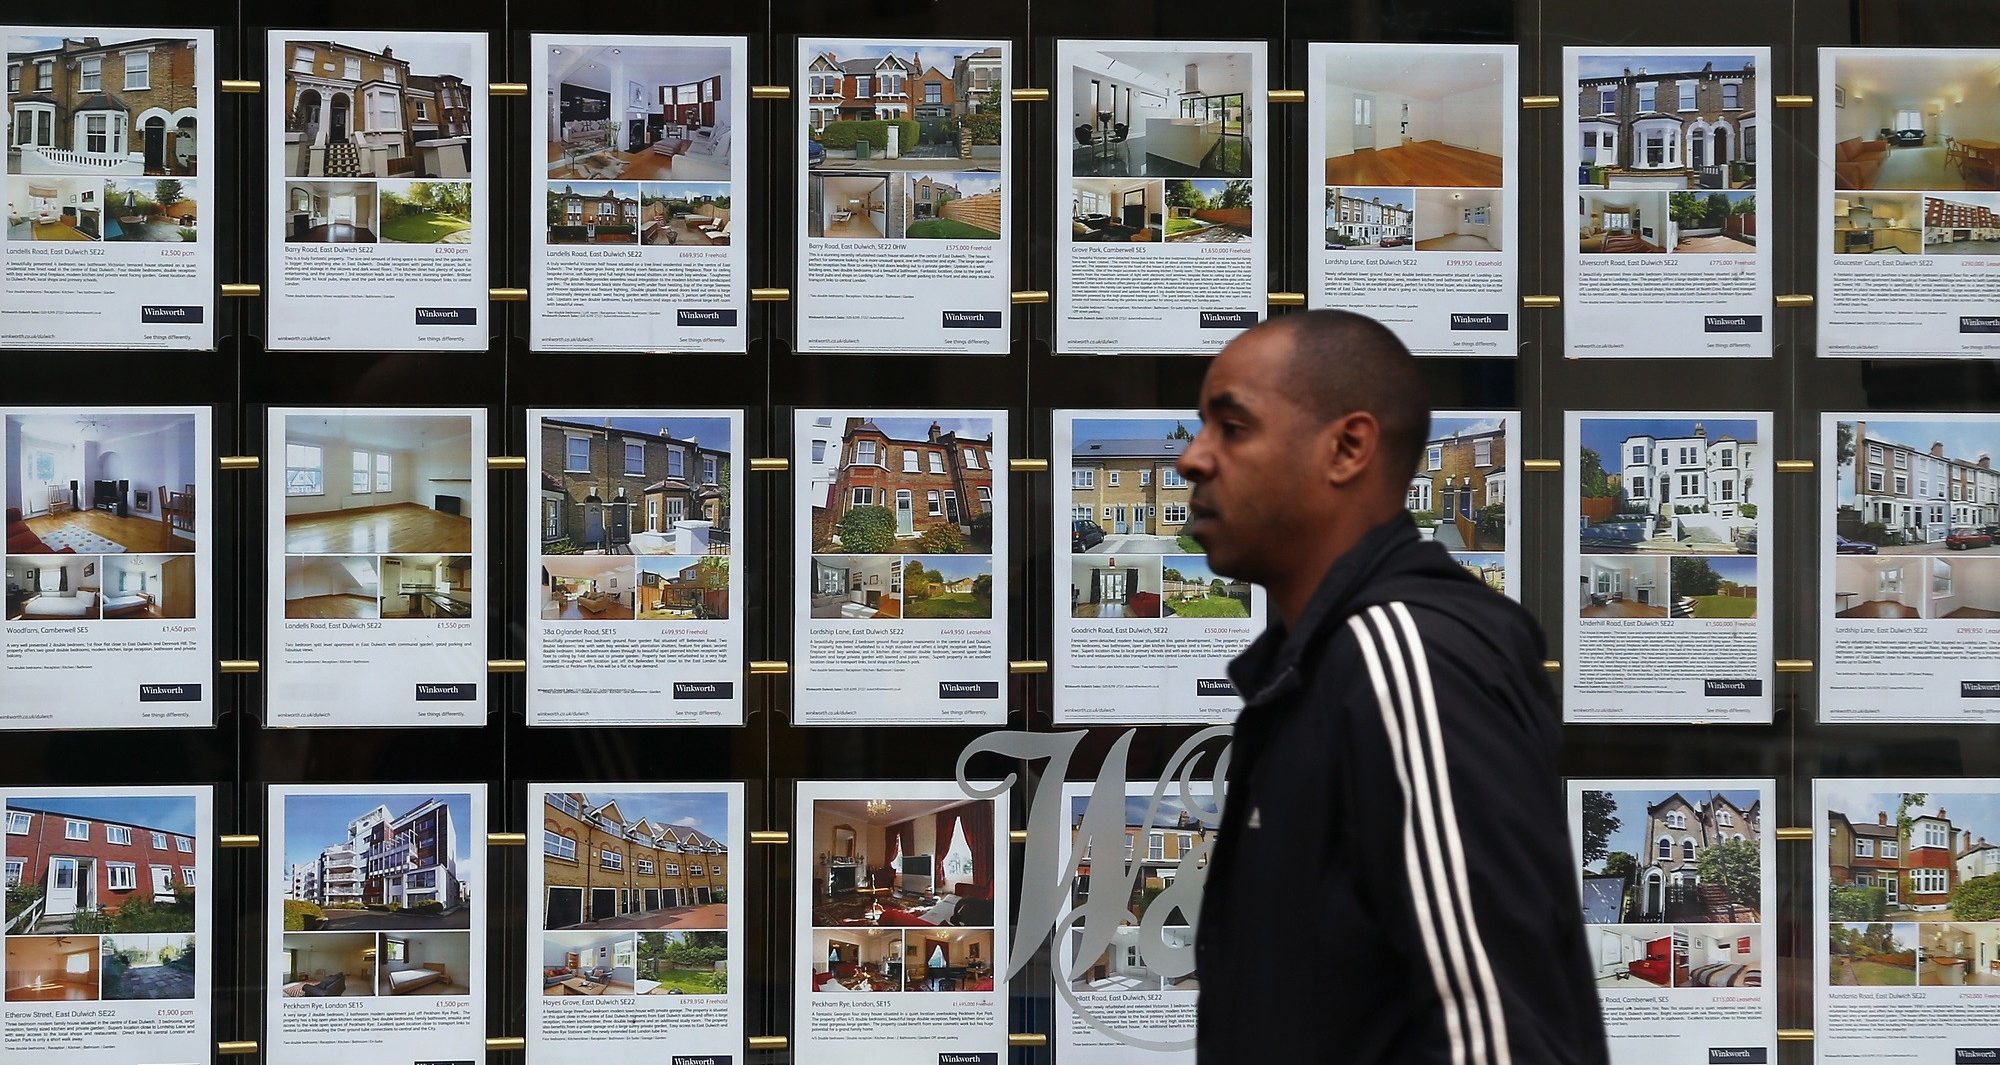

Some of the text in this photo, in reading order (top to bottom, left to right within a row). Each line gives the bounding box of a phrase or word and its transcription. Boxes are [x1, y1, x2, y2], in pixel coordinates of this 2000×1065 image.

[284, 246, 302, 254] Barry
[319, 246, 333, 254] East
[333, 246, 358, 254] Dulwich
[358, 246, 374, 254] SE22
[808, 243, 824, 251] Barry
[840, 243, 853, 251] East
[877, 243, 892, 251] SE22
[1071, 246, 1089, 254] Grove
[1102, 246, 1135, 254] Camberwell
[1135, 246, 1147, 254] SE5
[6, 248, 31, 256] Landells
[50, 248, 64, 256] East
[64, 248, 89, 256] Dulwich
[89, 248, 105, 256] SE22
[546, 250, 571, 258] Landells
[589, 250, 603, 258] East
[602, 250, 627, 258] Dulwich
[1324, 258, 1350, 266] Lordship
[1365, 258, 1379, 266] East
[1378, 258, 1403, 266] Dulwich
[1640, 259, 1664, 267] Dulwich
[1663, 259, 1679, 267] SE22
[144, 308, 185, 316] Winkworth
[418, 310, 459, 318] Winkworth
[679, 311, 720, 319] Winkworth
[945, 313, 985, 321] Winkworth
[1202, 313, 1242, 321] Winkworth
[1453, 316, 1492, 324] Winkworth
[1707, 317, 1746, 326] Winkworth
[284, 622, 310, 630] Landells
[328, 622, 342, 630] East
[341, 622, 366, 630] Dulwich
[366, 622, 382, 630] SE22
[1579, 620, 1606, 628] Underhill
[1636, 620, 1660, 628] Dulwich
[1659, 620, 1676, 628] SE22
[40, 627, 77, 635] Camberwell
[76, 627, 89, 635] SE5
[601, 628, 617, 636] SE15
[809, 628, 835, 636] Lordship
[851, 628, 865, 636] East
[865, 628, 889, 636] Dulwich
[889, 628, 905, 636] SE22
[1070, 627, 1098, 635] Goodrich
[1115, 627, 1128, 635] East
[1153, 627, 1169, 635] SE22
[675, 684, 716, 692] Winkworth
[942, 684, 981, 692] Winkworth
[1199, 681, 1234, 689] Winkwor
[1707, 682, 1746, 690] Winkworth
[142, 686, 184, 694] Winkworth
[418, 685, 459, 694] Winkworth
[542, 998, 562, 1006] Hayes
[581, 998, 595, 1006] East
[595, 998, 620, 1006] Dulwich
[619, 998, 636, 1006] SE22
[1072, 994, 1091, 1002] ellatt
[1108, 994, 1122, 1002] East
[1147, 994, 1163, 1002] SE22
[324, 1002, 348, 1010] London
[348, 1002, 364, 1010] SE15
[876, 1000, 892, 1008] SE15
[55, 1011, 71, 1019] East
[71, 1010, 97, 1019] Dulwich
[97, 1010, 116, 1019] SE22
[1711, 1049, 1750, 1058] Winkworth
[941, 1055, 981, 1063] Winkworth
